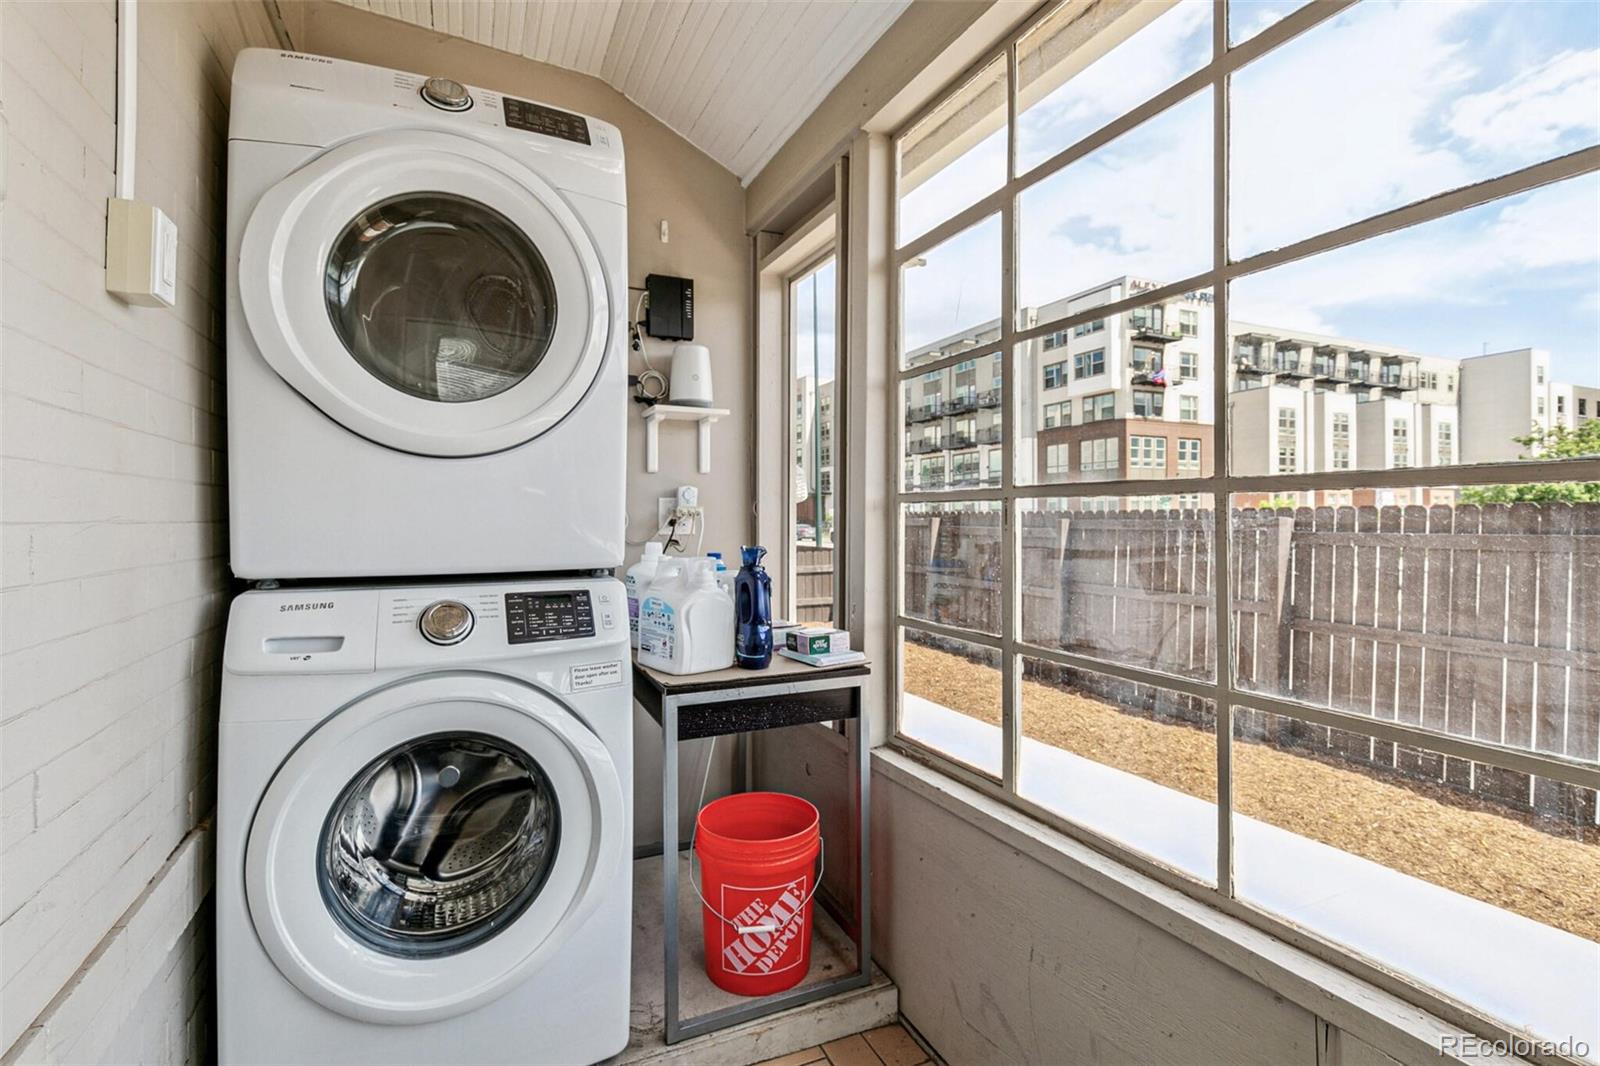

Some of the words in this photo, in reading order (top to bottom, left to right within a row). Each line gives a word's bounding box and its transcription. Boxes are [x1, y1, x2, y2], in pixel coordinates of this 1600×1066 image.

[280, 53, 333, 64] SAMSUNG
[280, 601, 334, 612] SAMSUNG
[723, 882, 805, 974] HOME
[732, 897, 768, 929] THE
[755, 909, 804, 974] DEPOT
